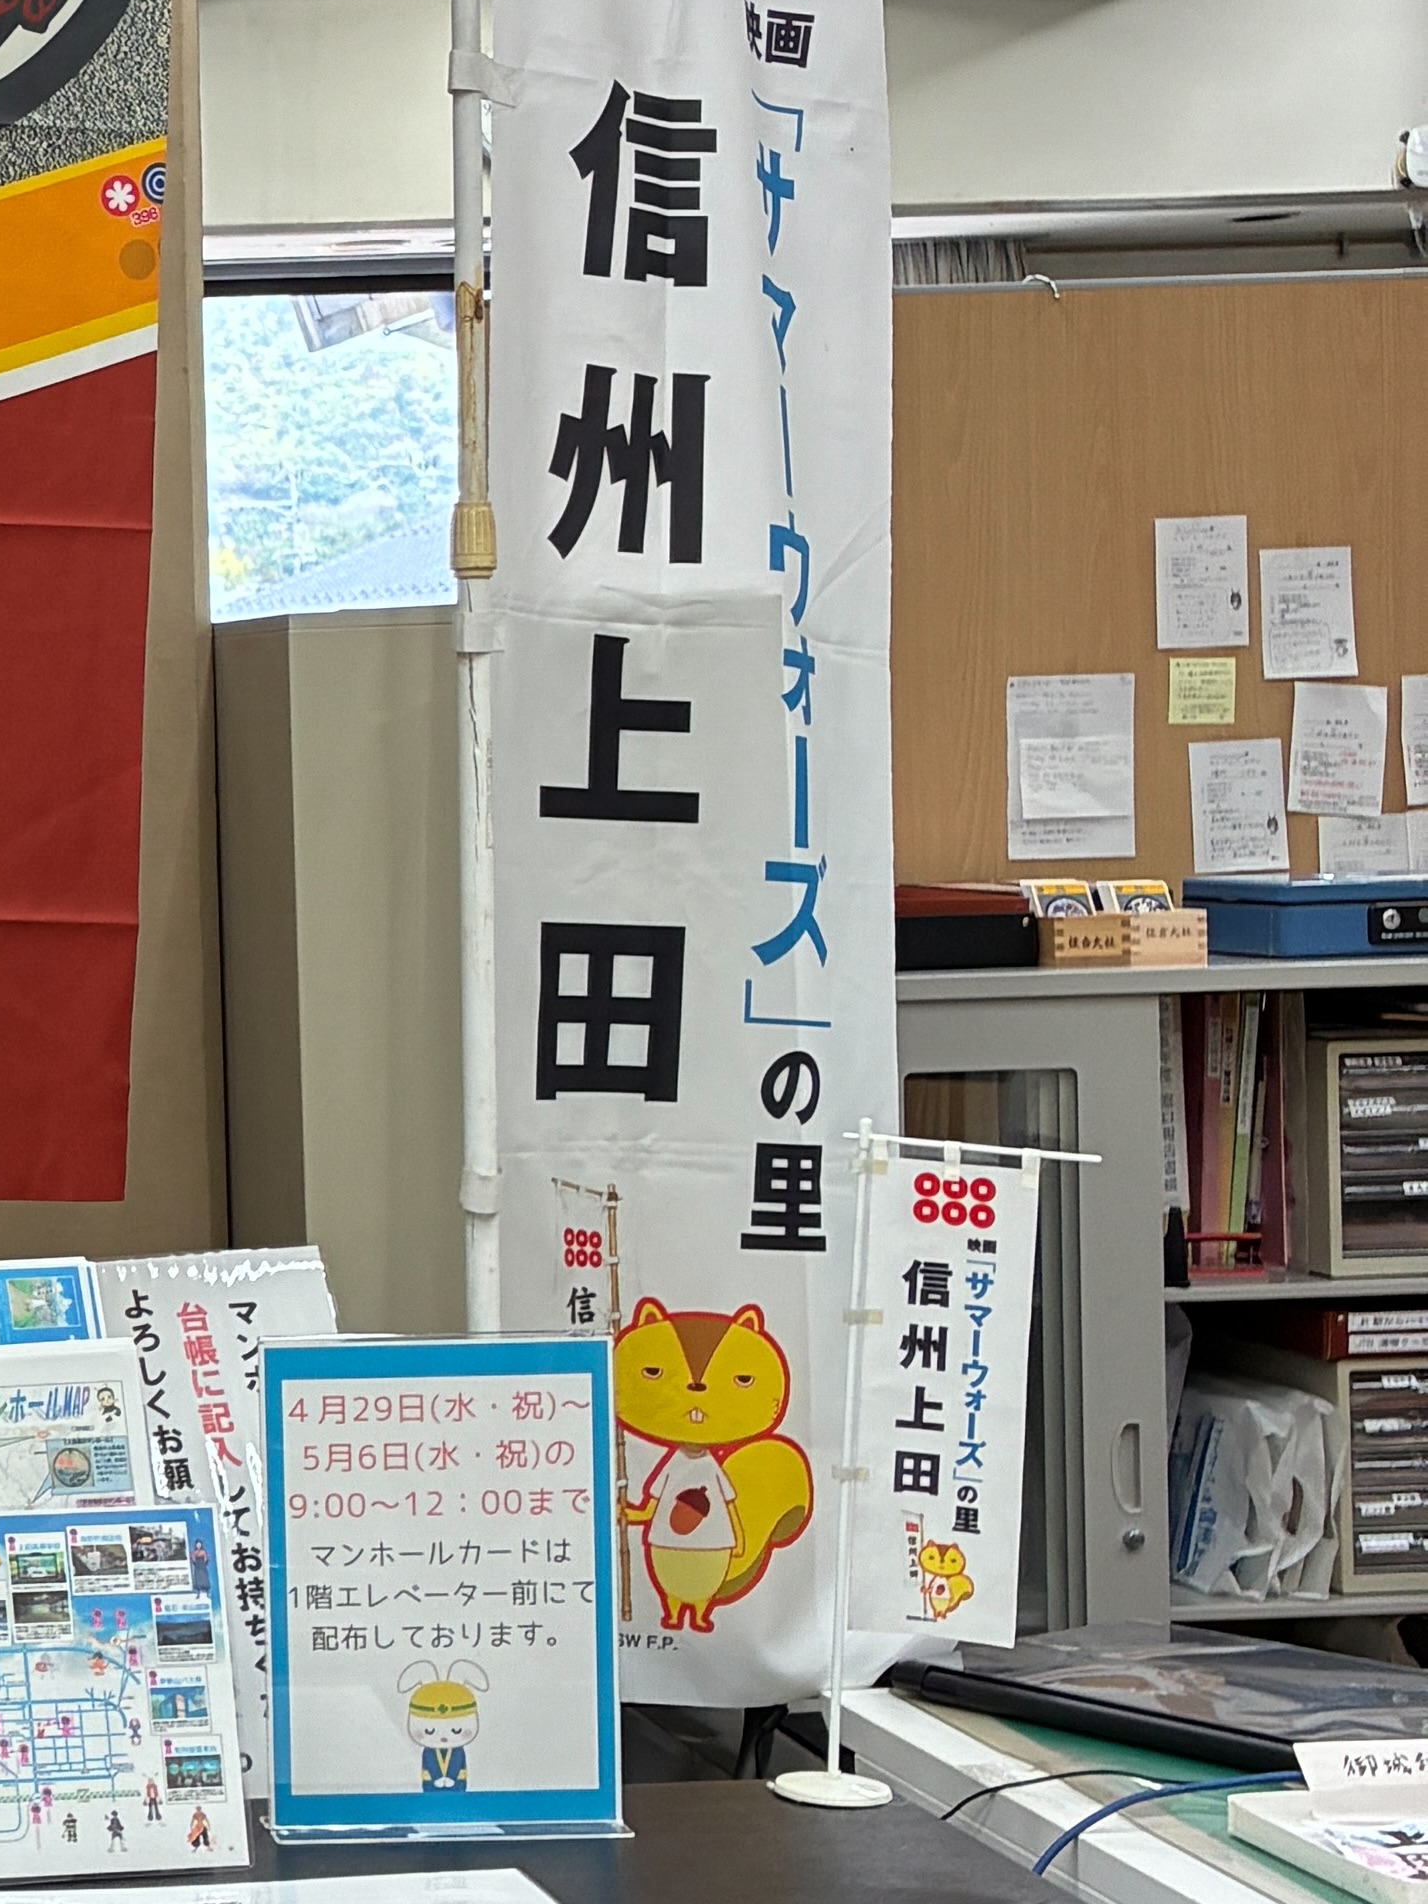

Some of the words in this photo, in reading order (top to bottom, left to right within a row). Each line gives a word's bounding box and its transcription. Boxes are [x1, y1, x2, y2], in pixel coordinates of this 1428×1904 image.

[537, 79, 719, 1103] 信州上田
[966, 1238, 998, 1255] 映画
[566, 1286, 598, 1326] 信
[892, 1259, 954, 1497] 信州上田
[951, 1259, 998, 1535] 「サマーウォーズ」の里
[310, 1538, 573, 1568] マンホールカードは
[287, 1578, 595, 1611] 1階エレベーター前にて
[311, 1620, 558, 1652] 配布しております。
